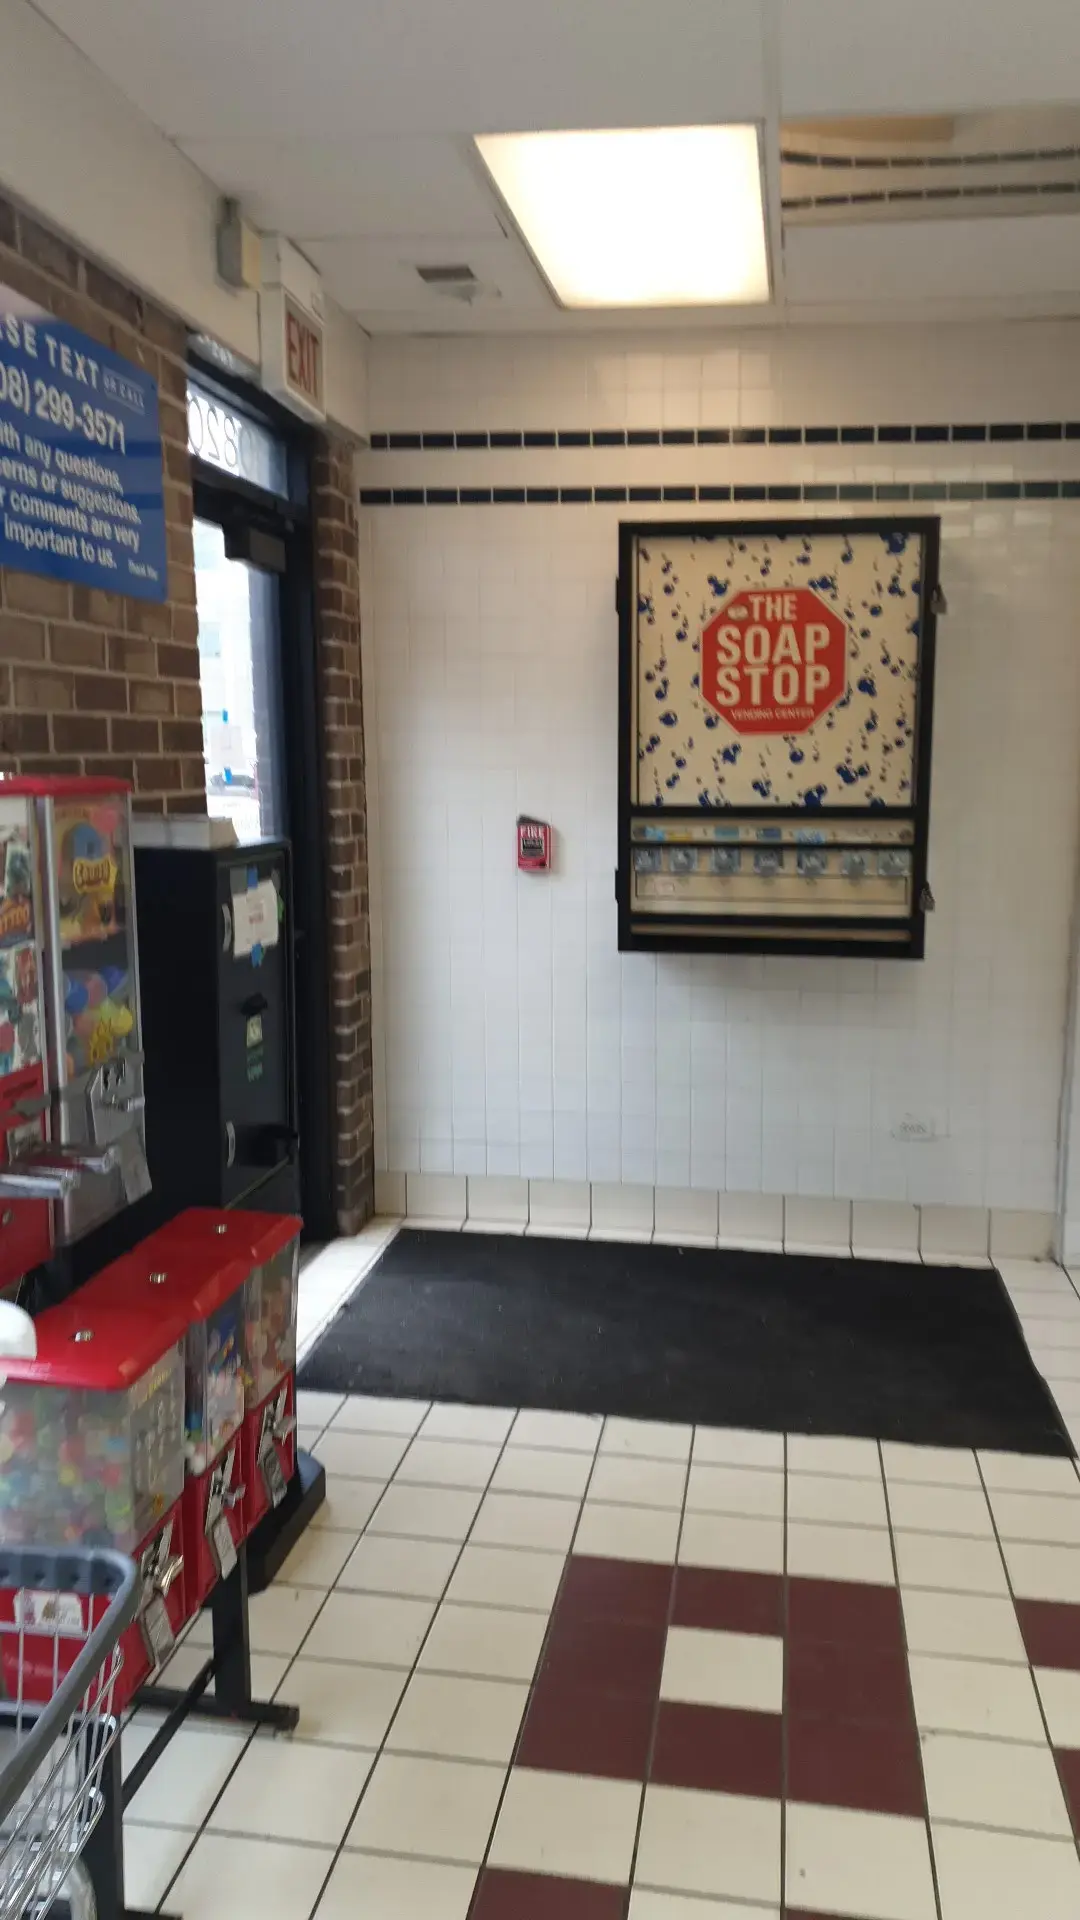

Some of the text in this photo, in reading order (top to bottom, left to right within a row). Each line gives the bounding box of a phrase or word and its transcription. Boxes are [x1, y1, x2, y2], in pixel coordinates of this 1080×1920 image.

[45, 332, 99, 390] TEXT
[286, 311, 320, 401] EXIT
[34, 378, 126, 456] 299-3571
[24, 434, 51, 469] any
[41, 471, 58, 495] or
[10, 490, 88, 534] comments
[91, 516, 112, 540] are
[114, 524, 140, 554] very
[81, 537, 95, 563] to
[98, 547, 118, 569] us.
[748, 594, 798, 622] THE
[716, 623, 831, 665] SOAP
[716, 664, 831, 707] STOP
[730, 707, 815, 721] VENDING CENTER
